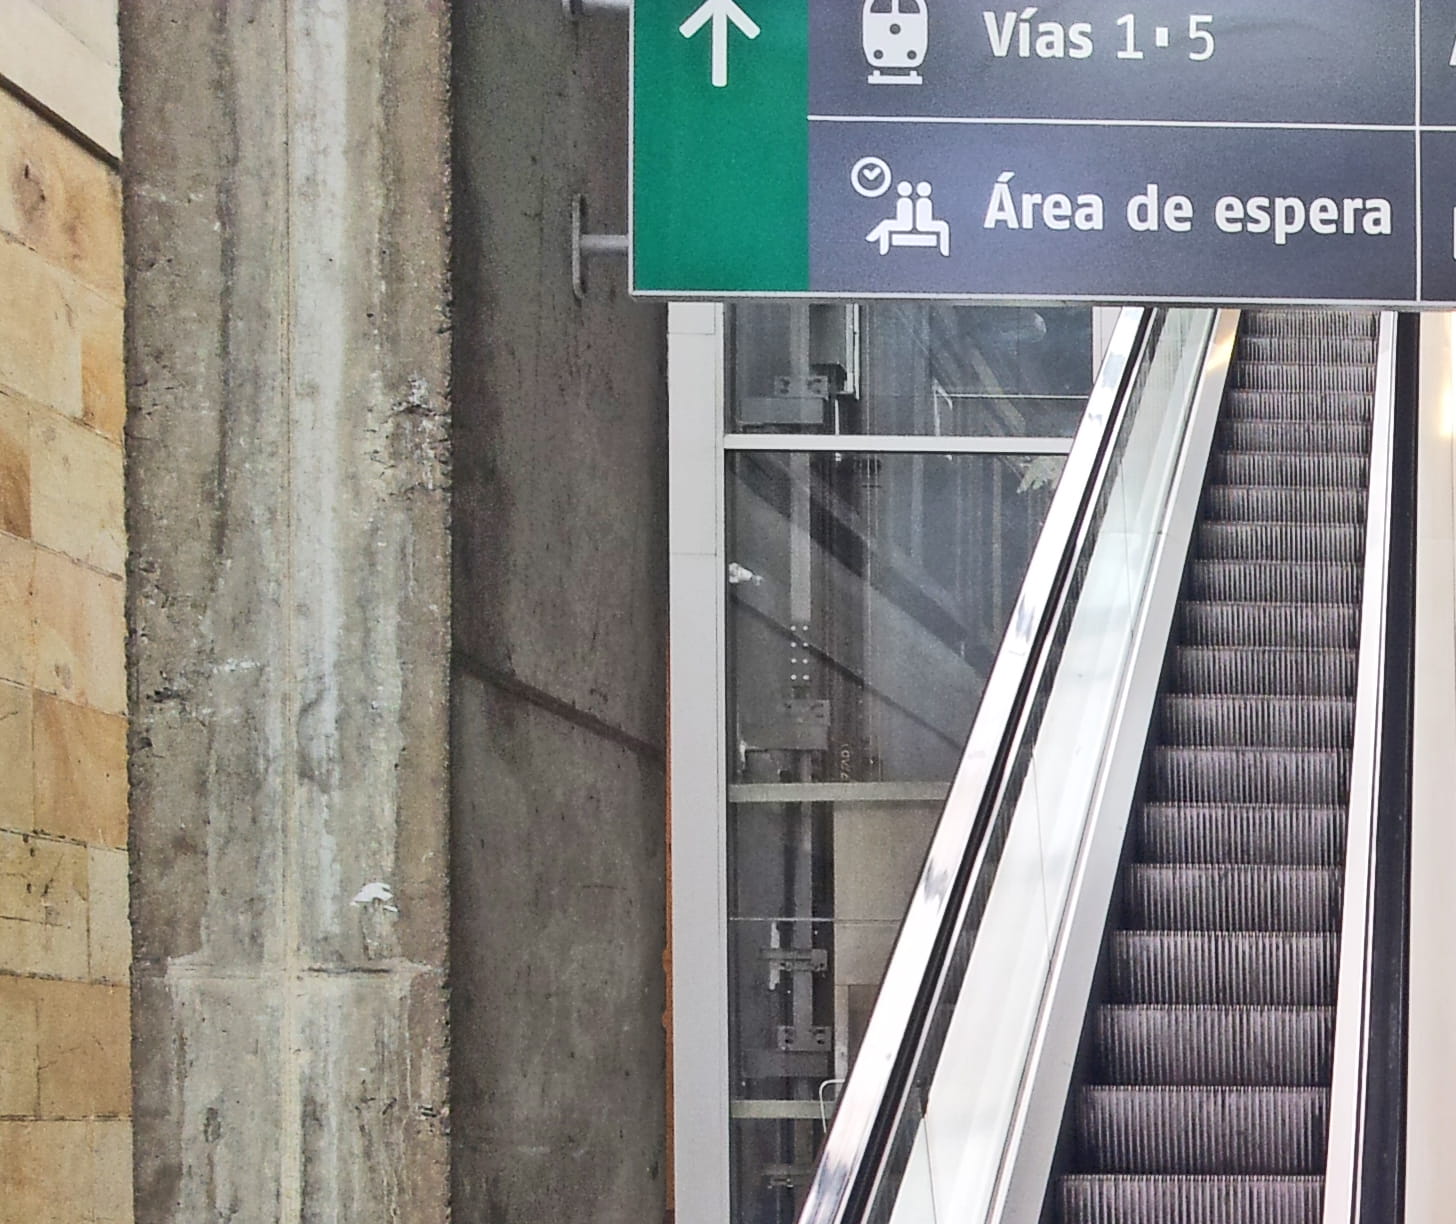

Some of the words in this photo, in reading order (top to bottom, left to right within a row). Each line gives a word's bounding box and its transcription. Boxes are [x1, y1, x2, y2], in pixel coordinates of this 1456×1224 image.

[983, 7, 1093, 59] Vías
[984, 172, 1104, 231] Área
[1127, 184, 1194, 232] de
[1215, 197, 1392, 245] espera
